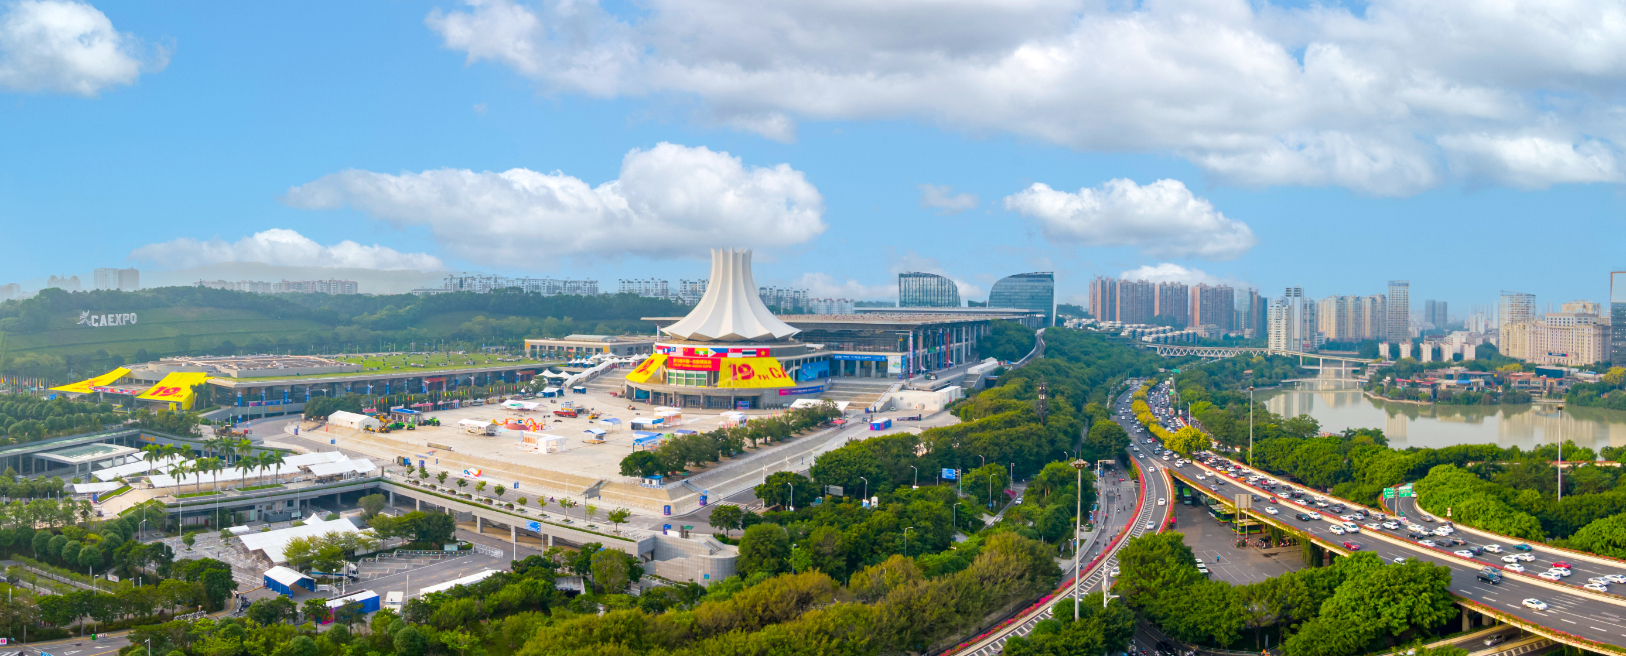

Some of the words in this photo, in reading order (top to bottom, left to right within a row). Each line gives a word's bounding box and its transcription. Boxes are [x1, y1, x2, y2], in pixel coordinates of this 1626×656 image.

[91, 312, 137, 327] CAEXPO
[727, 363, 755, 381] 19
[149, 386, 182, 397] 19
